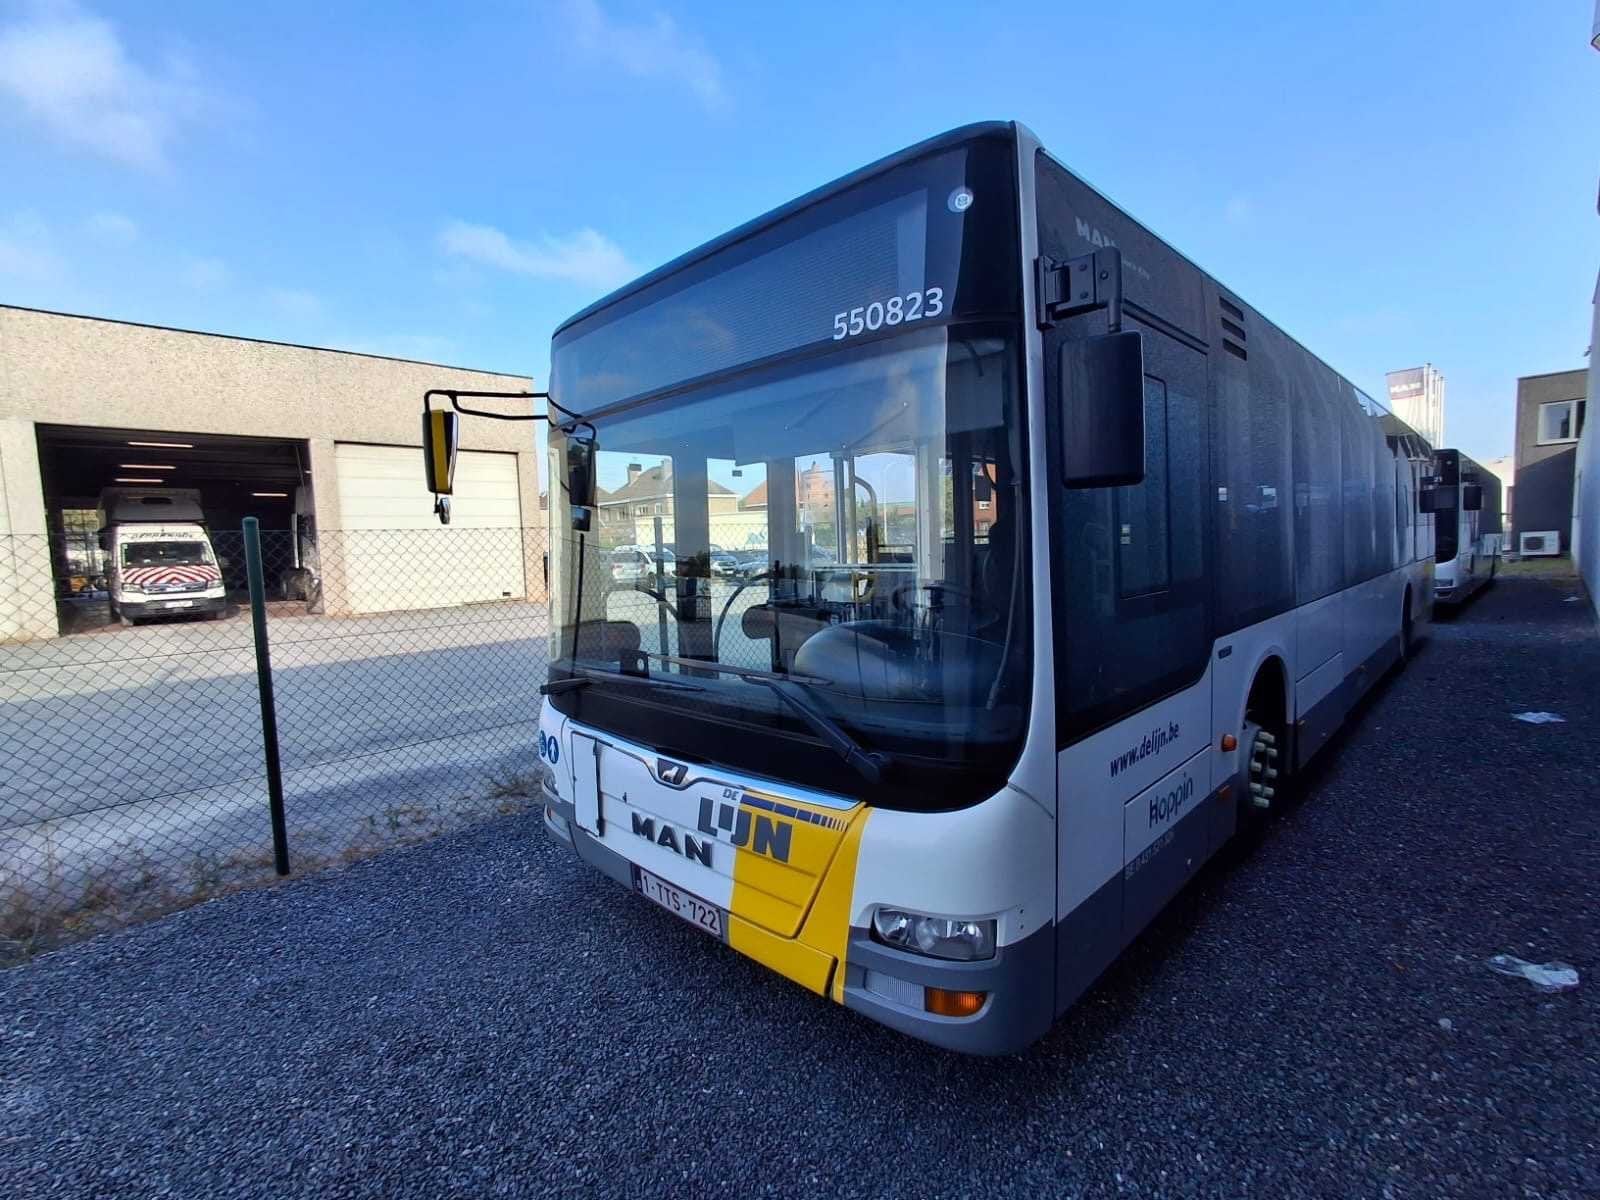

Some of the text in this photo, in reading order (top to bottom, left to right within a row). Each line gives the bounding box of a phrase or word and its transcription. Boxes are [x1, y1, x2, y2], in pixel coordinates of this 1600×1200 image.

[832, 287, 944, 341] 550823
[1110, 721, 1180, 778] www.delijn.be
[723, 788, 739, 801] DE
[1149, 772, 1193, 828] Hoppin
[631, 811, 713, 868] MAN
[697, 797, 794, 864] LIJN
[643, 875, 718, 931] 1-TTS-722
